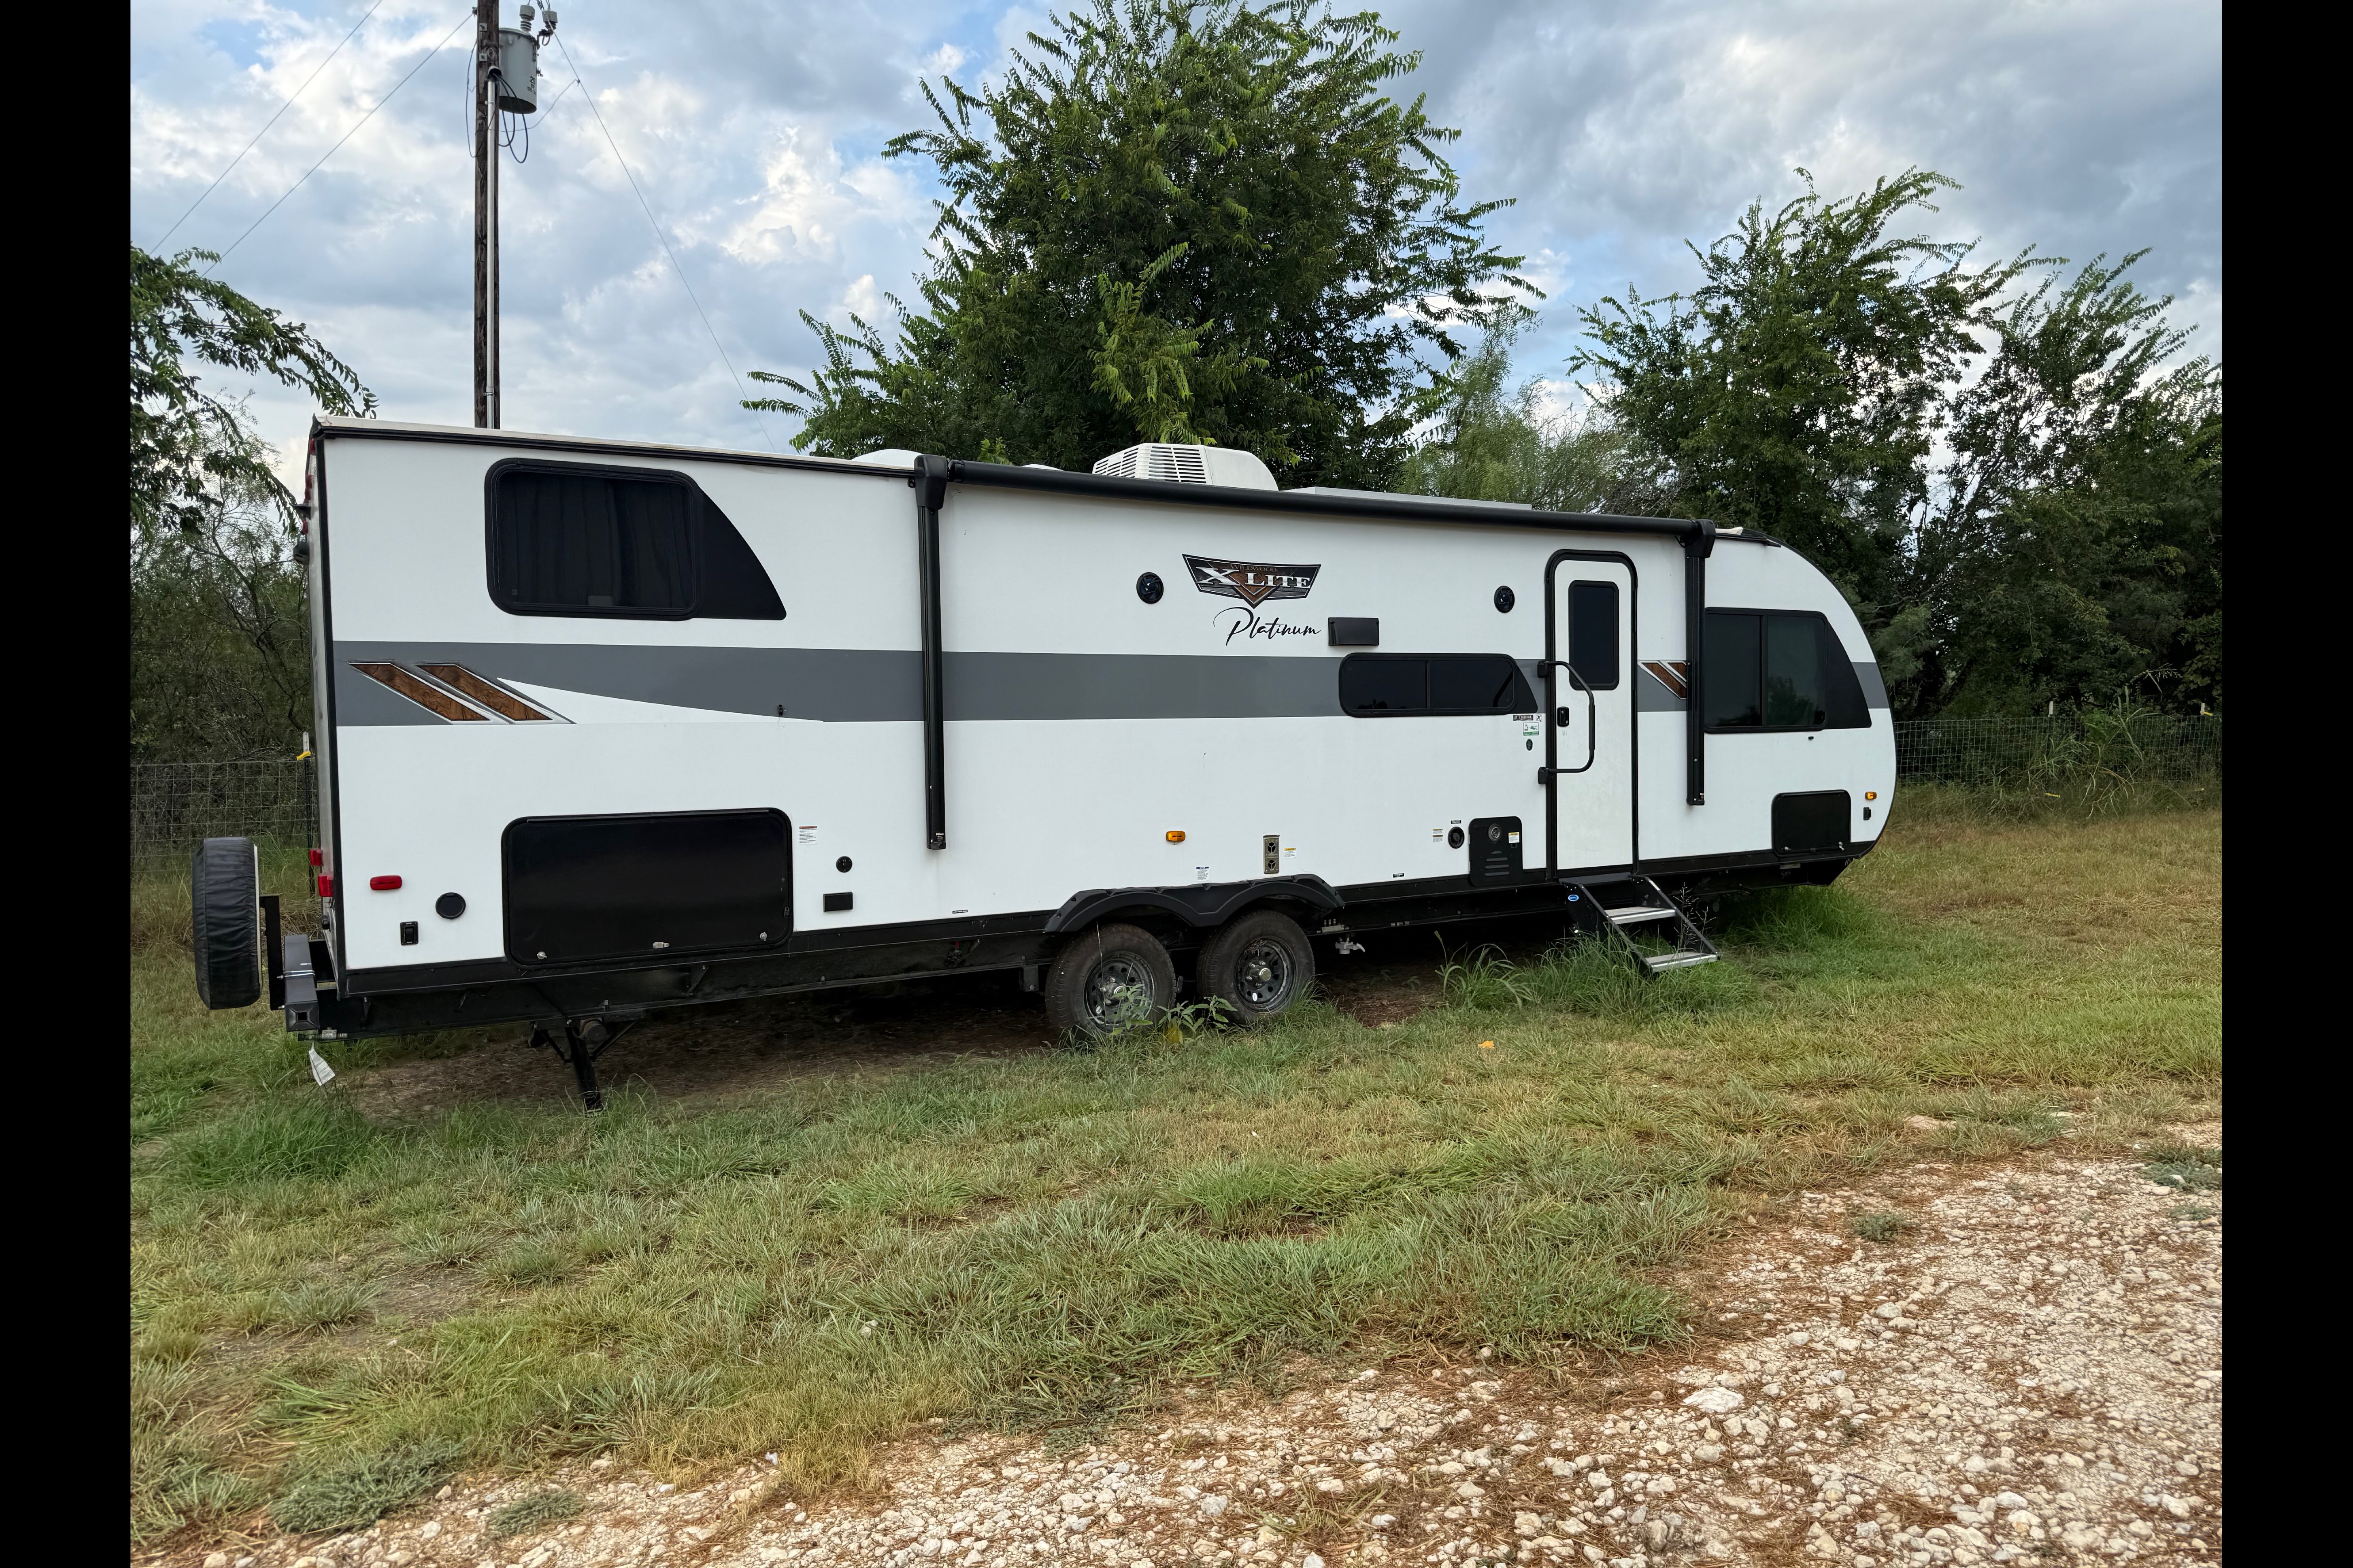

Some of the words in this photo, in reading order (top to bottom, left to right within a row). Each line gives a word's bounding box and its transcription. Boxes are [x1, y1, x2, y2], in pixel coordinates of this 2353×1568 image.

[1196, 566, 1241, 586] X
[1245, 572, 1311, 589] LITE
[1230, 564, 1277, 572] WILDWOOD
[1213, 606, 1322, 646] Platinum
